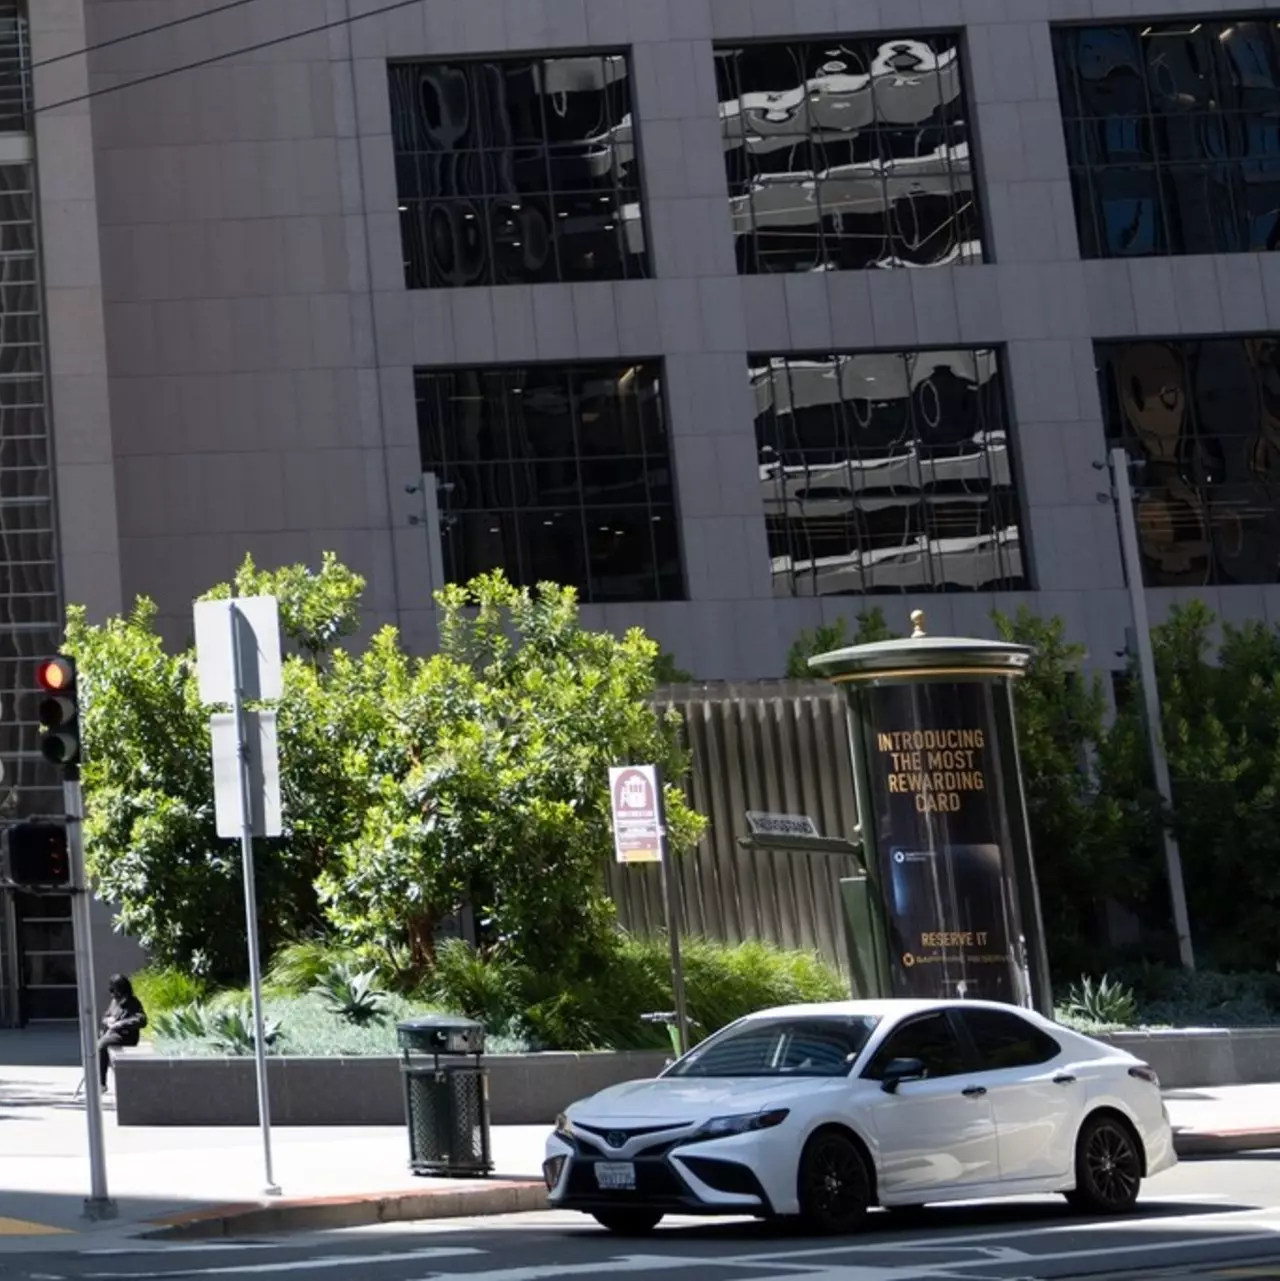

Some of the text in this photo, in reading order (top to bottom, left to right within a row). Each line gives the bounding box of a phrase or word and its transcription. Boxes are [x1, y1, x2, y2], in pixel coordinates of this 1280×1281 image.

[877, 729, 984, 751] INTRODUCING
[890, 750, 975, 771] THE MOST
[888, 771, 984, 792] REWARDING
[915, 792, 960, 812] CARD
[920, 931, 988, 947] RESERVE IT
